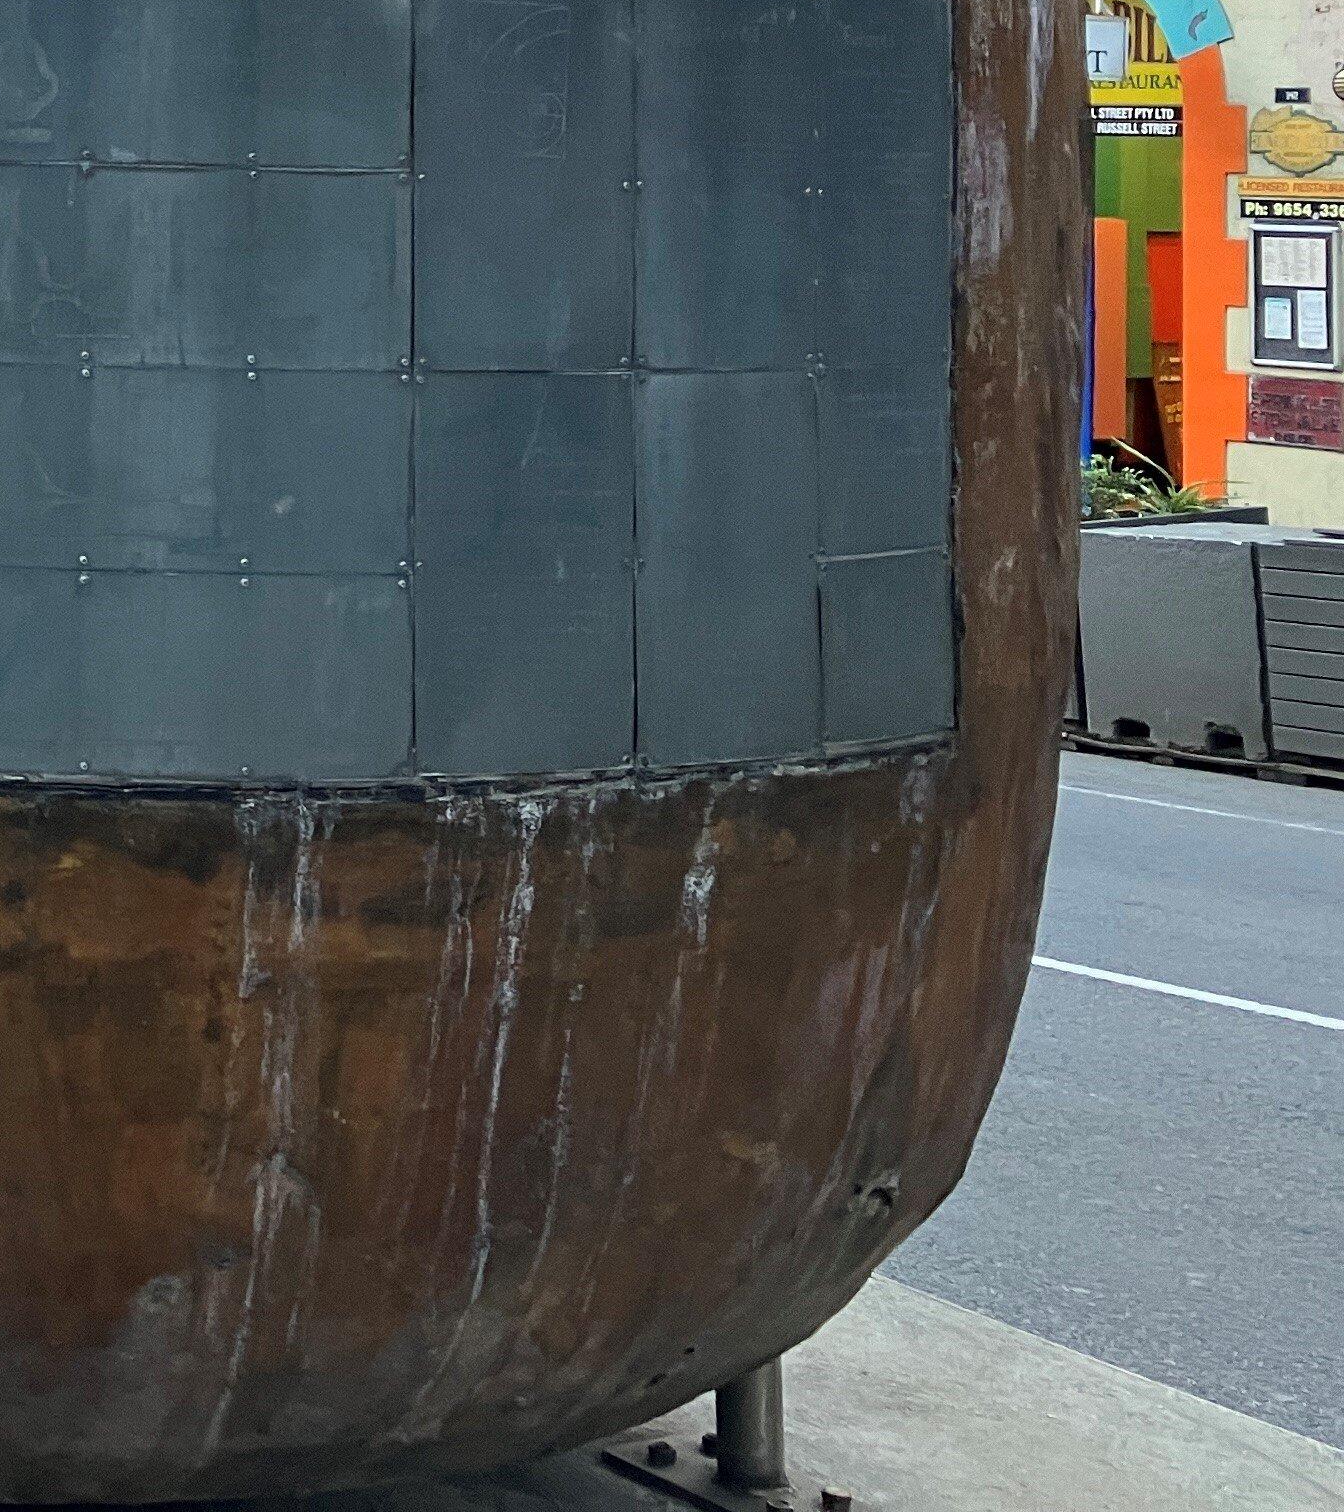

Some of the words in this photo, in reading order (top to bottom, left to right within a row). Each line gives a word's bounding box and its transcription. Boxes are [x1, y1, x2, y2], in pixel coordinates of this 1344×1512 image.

[1098, 107, 1133, 119] STREET
[1134, 108, 1153, 119] PTY
[1155, 108, 1174, 120] LTD
[1097, 122, 1139, 134] RUSSELL
[1140, 123, 1178, 135] STREET
[1245, 201, 1269, 216] Ph:
